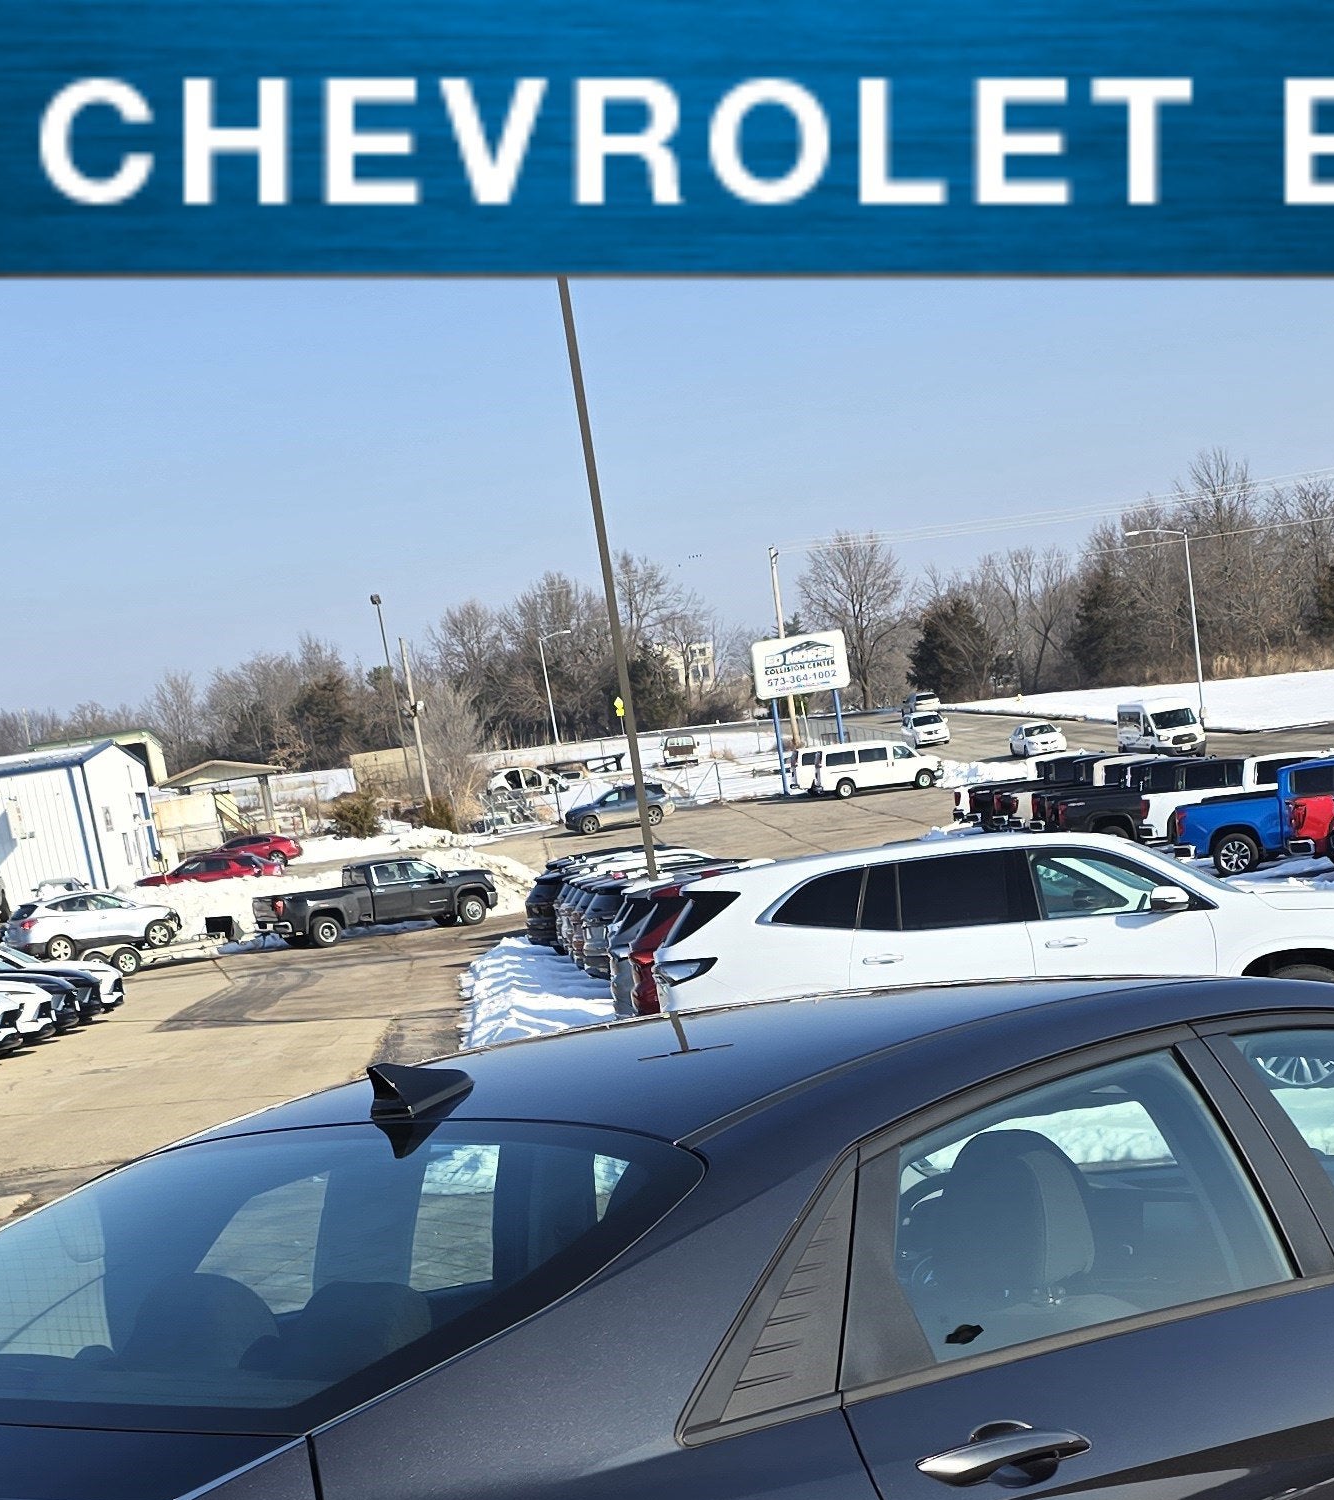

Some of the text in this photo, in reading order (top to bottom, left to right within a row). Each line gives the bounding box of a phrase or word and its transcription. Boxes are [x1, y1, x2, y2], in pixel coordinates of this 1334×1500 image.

[765, 659, 836, 676] COLLISION CENTER
[767, 669, 837, 687] 573-364-1002
